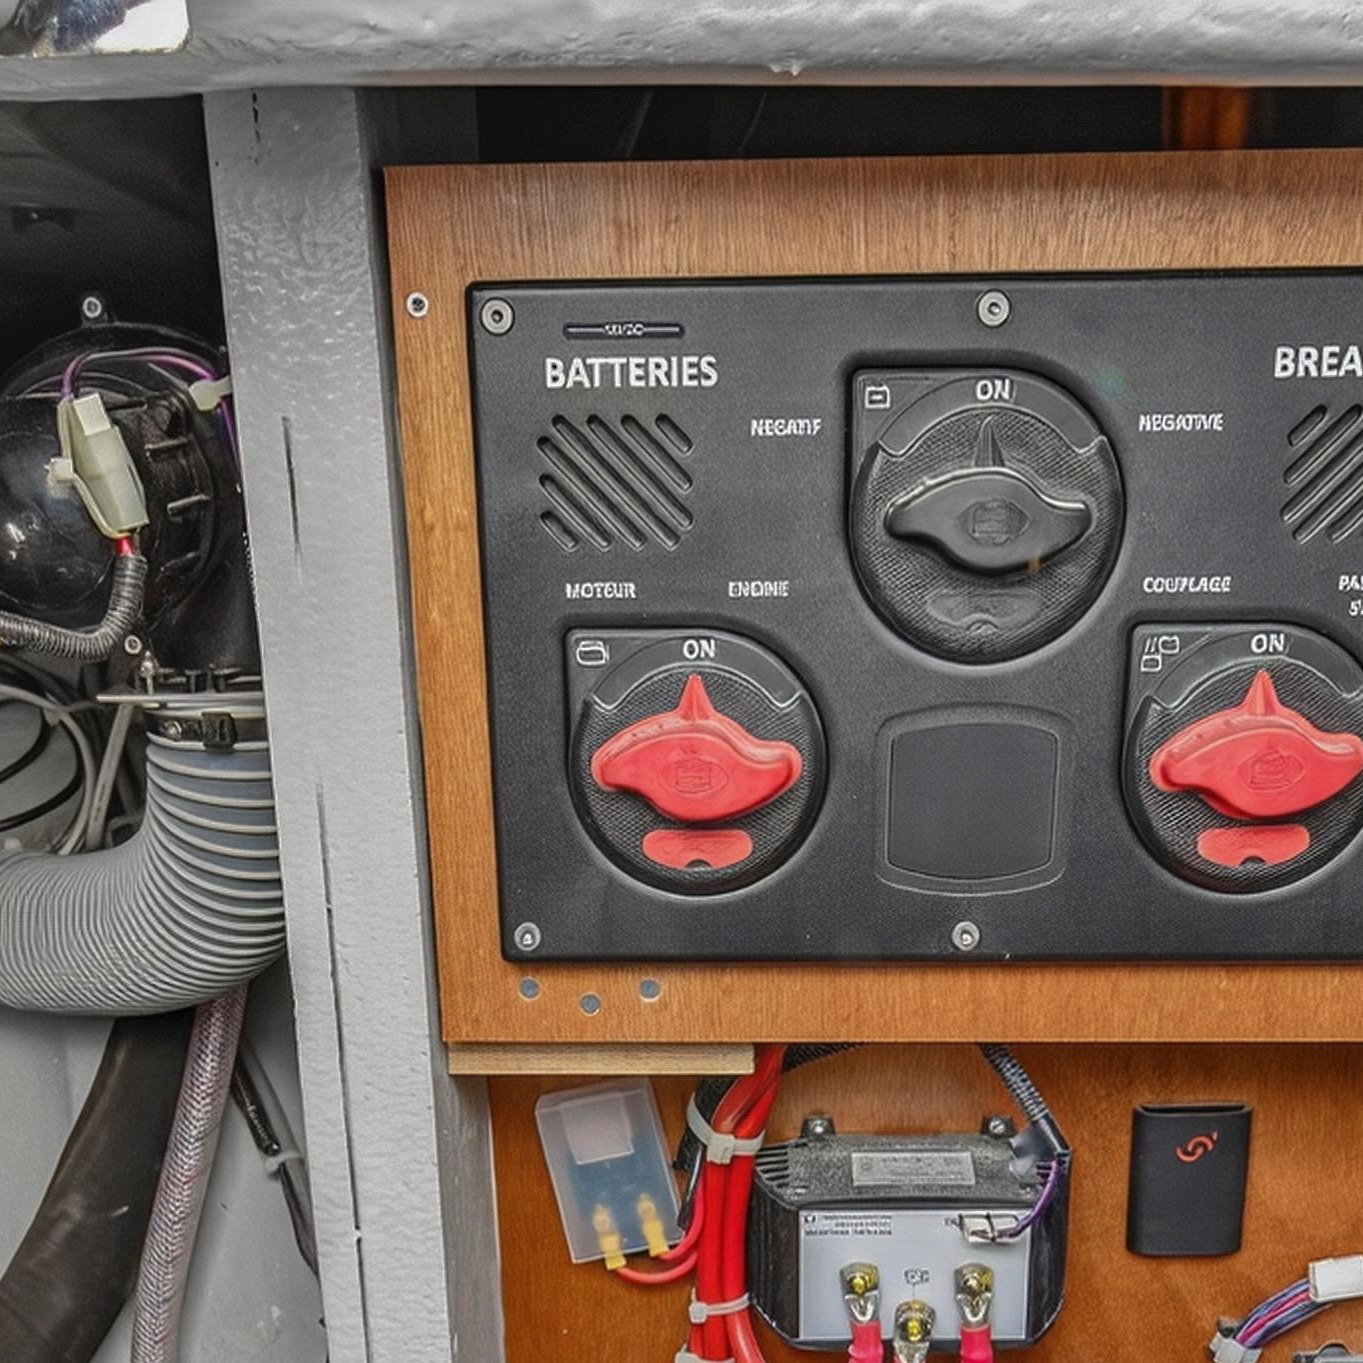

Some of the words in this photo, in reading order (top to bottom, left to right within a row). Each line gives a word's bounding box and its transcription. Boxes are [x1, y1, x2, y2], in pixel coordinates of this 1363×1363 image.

[544, 355, 719, 389] BATTERIES
[974, 379, 1012, 401] ON
[565, 582, 637, 599] MOTEUR
[682, 638, 716, 659] ON
[1250, 632, 1285, 653] ON
